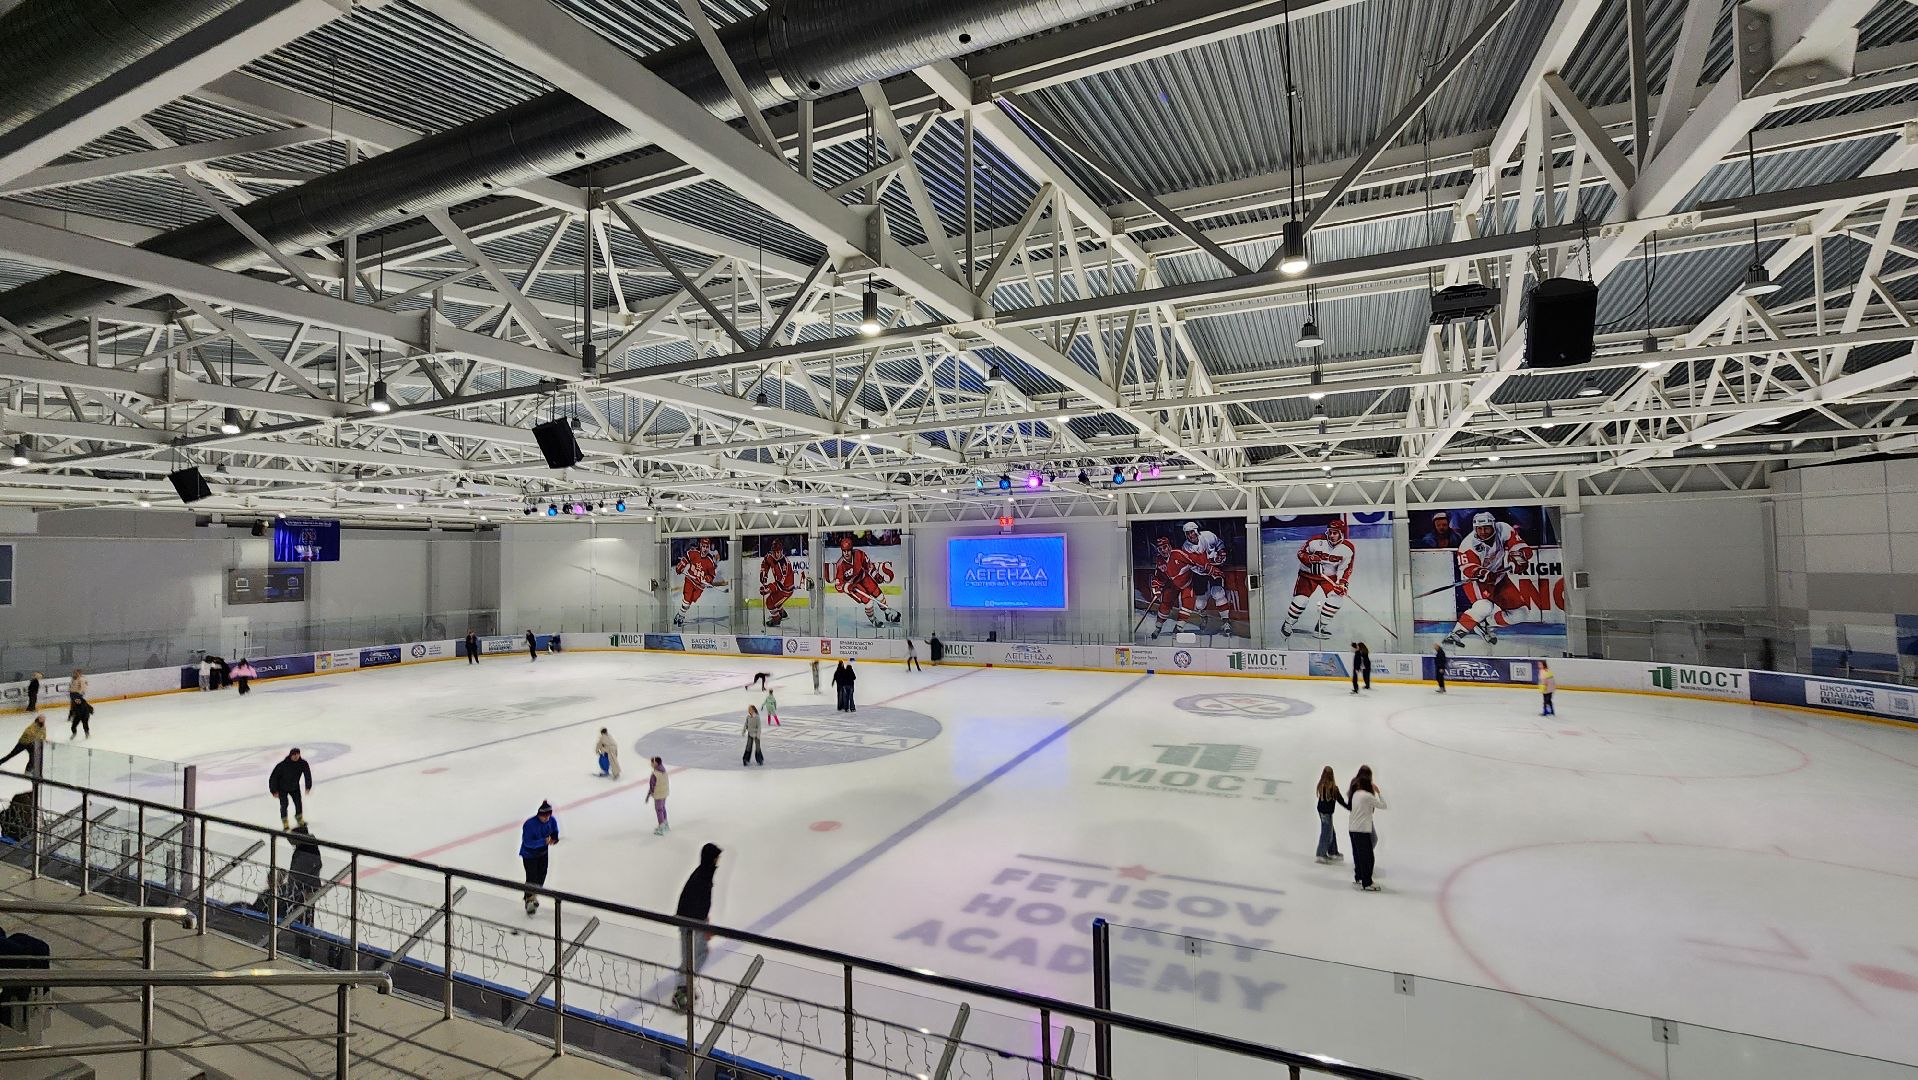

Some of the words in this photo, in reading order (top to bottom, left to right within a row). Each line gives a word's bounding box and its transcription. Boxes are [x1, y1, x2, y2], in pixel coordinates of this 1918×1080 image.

[965, 568, 1048, 581] ЛЕГЕНДА
[620, 634, 643, 644] МОСТ
[945, 644, 975, 656] МОСТ
[1247, 653, 1288, 667] МОСТ
[1680, 668, 1742, 689] МОСТ
[1819, 684, 1857, 694] ШКОЛА
[1820, 690, 1876, 704] ПЛАВАНИЯ
[1100, 764, 1294, 797] МОСТ
[990, 866, 1283, 928] FETISOV
[960, 892, 1274, 964] HOCKEY
[892, 918, 1288, 1013] ACADEMY
